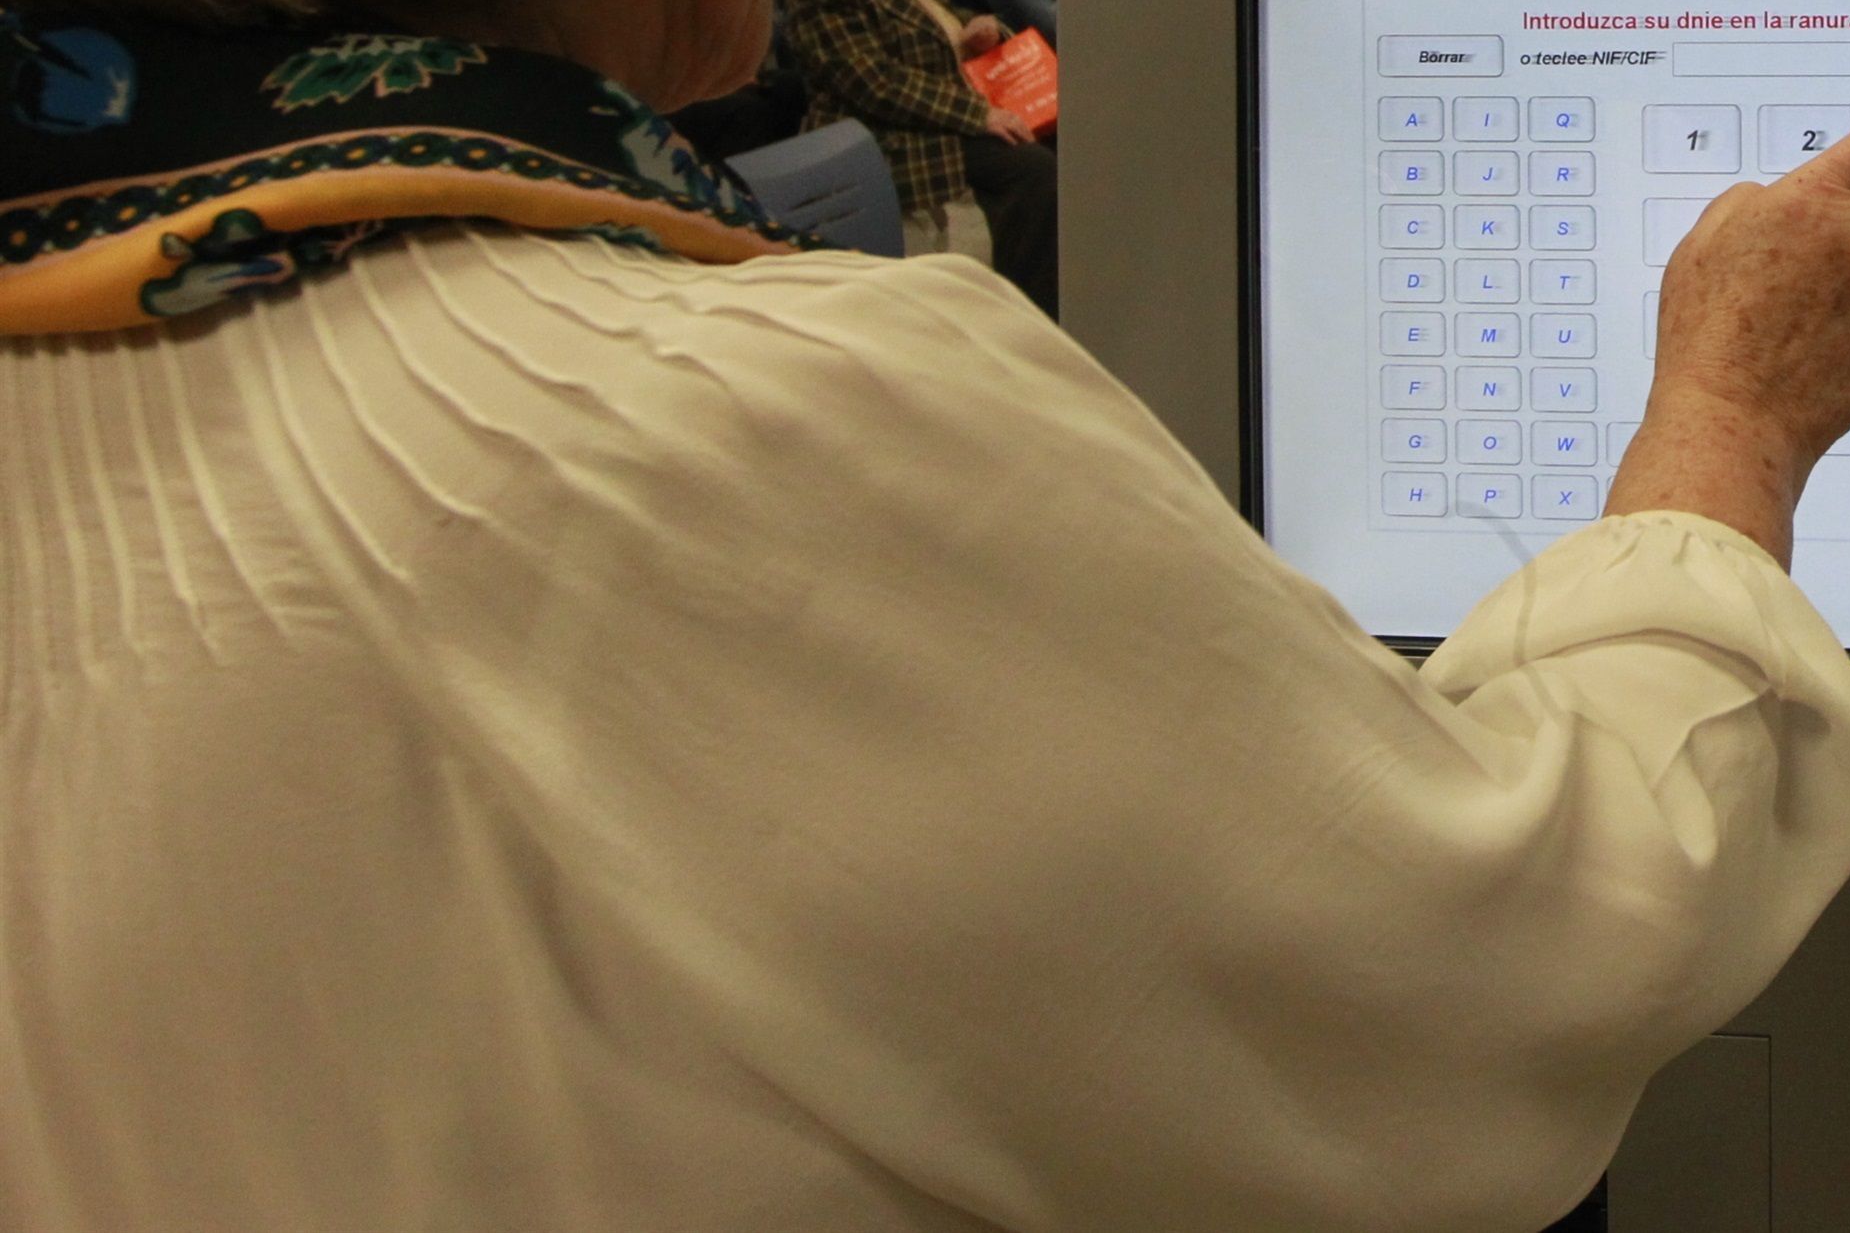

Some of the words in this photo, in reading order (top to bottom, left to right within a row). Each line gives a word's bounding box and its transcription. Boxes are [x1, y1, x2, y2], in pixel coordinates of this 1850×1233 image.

[1522, 11, 1637, 31] Introduzca
[1645, 14, 1670, 31] su
[1677, 11, 1723, 31] dnie
[1730, 14, 1756, 31] en
[1764, 11, 1782, 29] la
[1419, 50, 1466, 65] Borrar
[1520, 52, 1531, 65] o
[1536, 50, 1587, 65] teclee
[1591, 50, 1658, 66] NIF/CIF
[1406, 114, 1417, 126] A
[1557, 113, 1569, 127] Q
[1688, 130, 1698, 150] 1
[1802, 130, 1816, 151] 2
[1407, 167, 1418, 180] B
[1483, 168, 1493, 181] J
[1557, 168, 1569, 181] R
[1407, 221, 1419, 234] C
[1482, 221, 1494, 234] K
[1557, 222, 1569, 235] S
[1408, 275, 1419, 288] D
[1483, 276, 1492, 288] L
[1560, 276, 1571, 289] T
[1408, 328, 1419, 341] E
[1482, 329, 1496, 342] M
[1559, 330, 1571, 343] U
[1409, 382, 1421, 394] F
[1483, 383, 1496, 396] N
[1560, 384, 1571, 397] V
[1409, 435, 1421, 448] G
[1484, 436, 1497, 449] O
[1558, 438, 1574, 451] W
[1410, 489, 1422, 501] H
[1484, 490, 1496, 502] P
[1559, 492, 1572, 504] X
